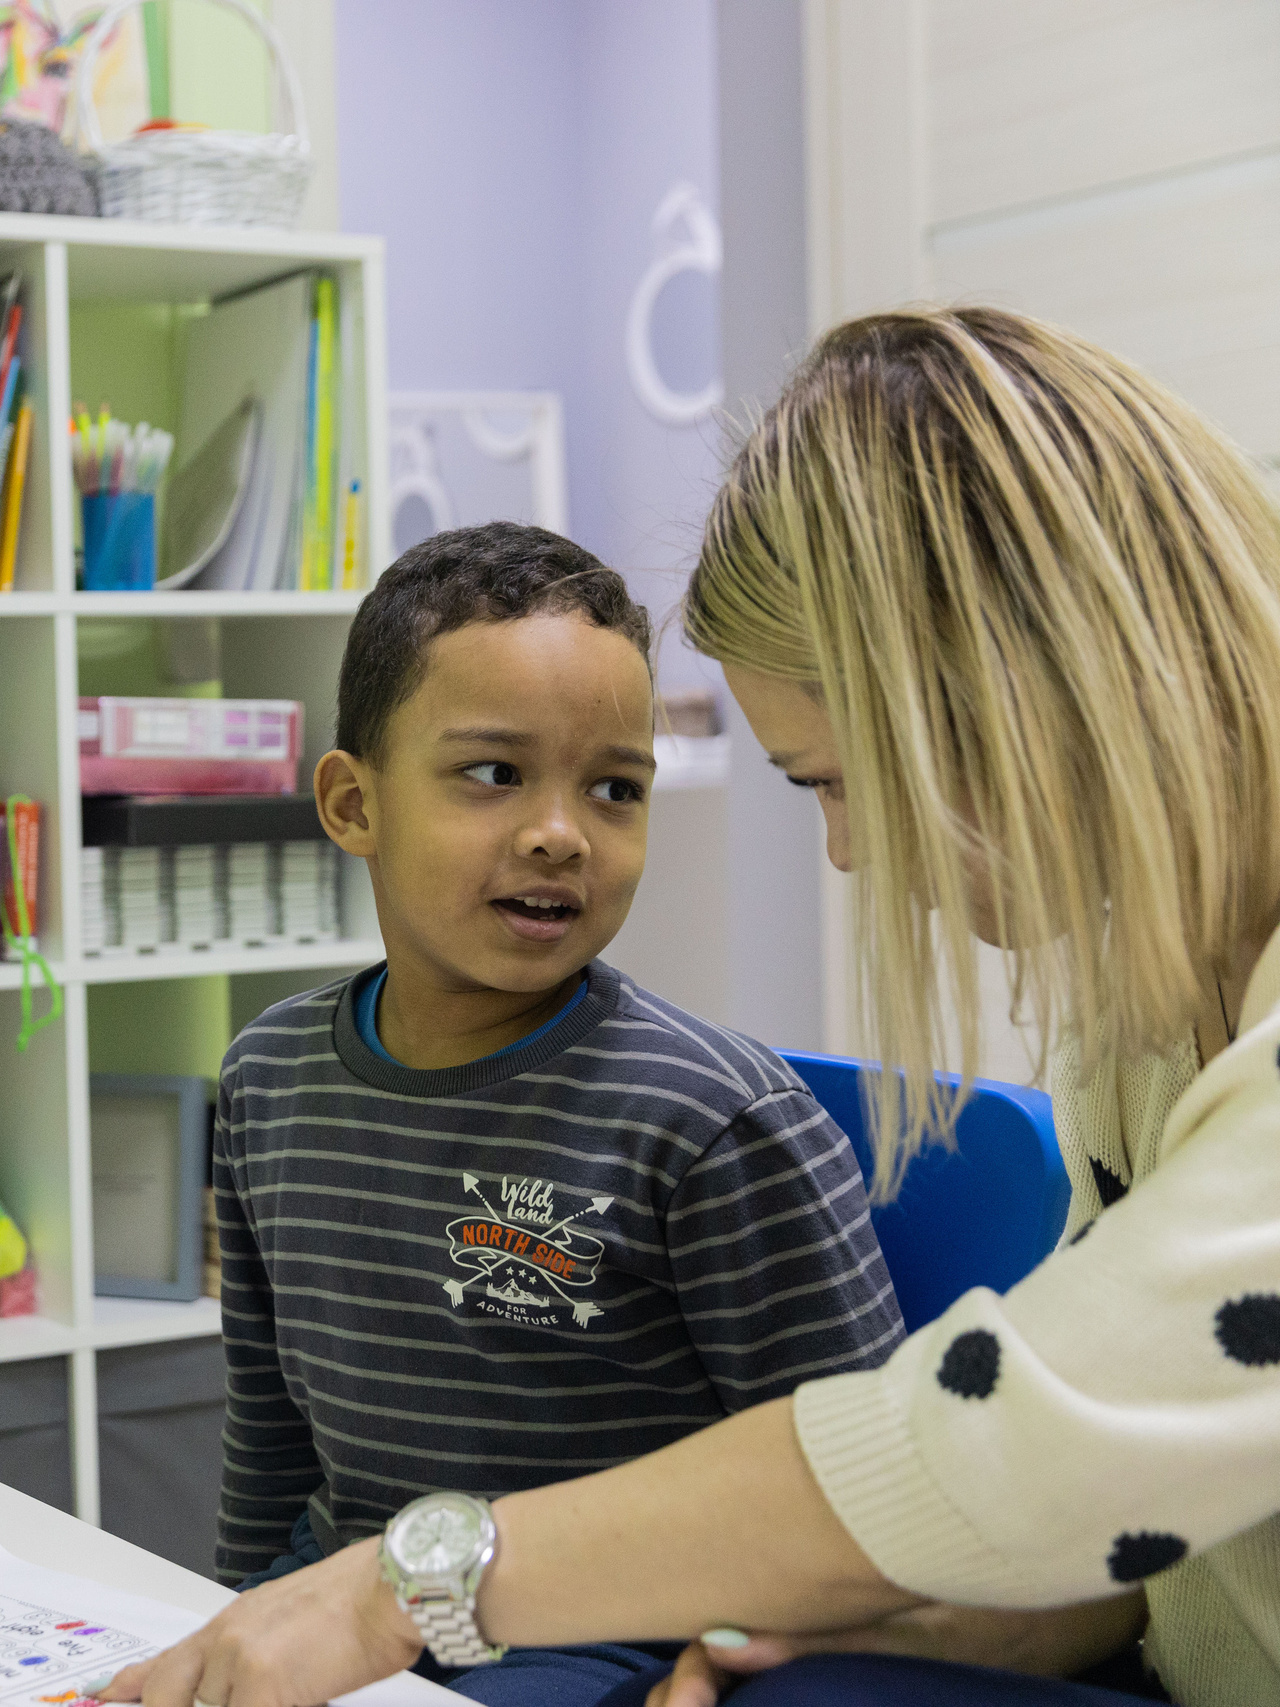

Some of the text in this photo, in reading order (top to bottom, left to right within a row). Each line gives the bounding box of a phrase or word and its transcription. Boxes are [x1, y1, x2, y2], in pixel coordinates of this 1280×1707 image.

[501, 1176, 554, 1208] Wild
[507, 1199, 554, 1225] Land
[462, 1224, 577, 1279] NORTH SIDE
[476, 1300, 559, 1326] ADVENTURE
[506, 1304, 527, 1315] FOR
[0, 1623, 44, 1636] eight
[58, 1639, 93, 1656] five
